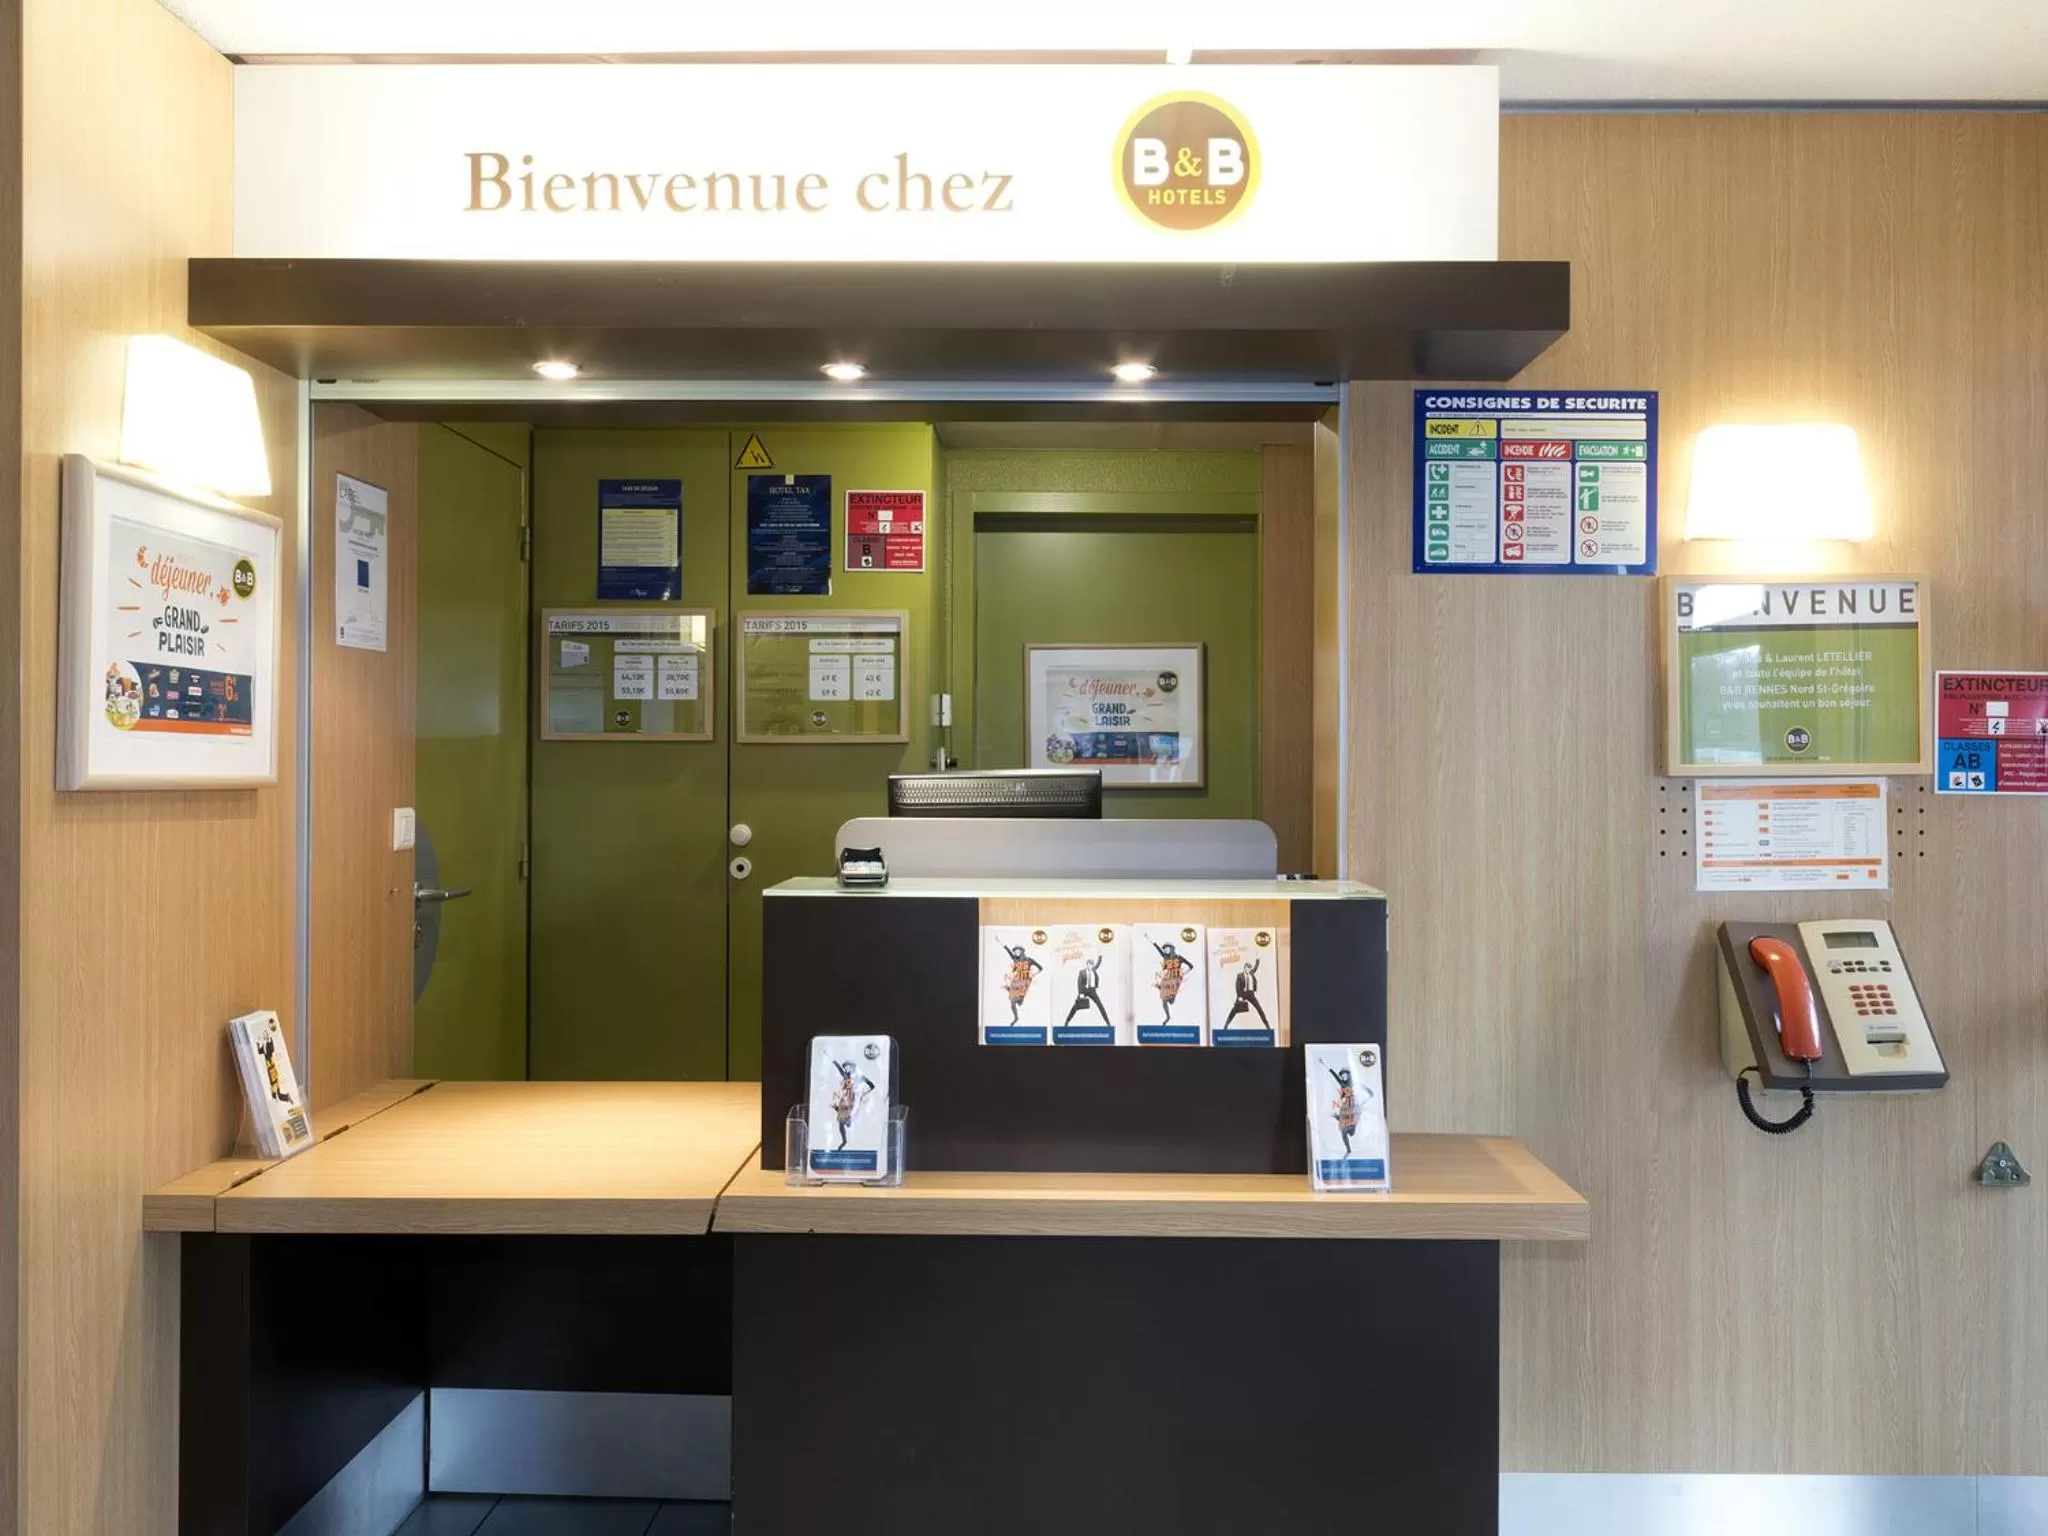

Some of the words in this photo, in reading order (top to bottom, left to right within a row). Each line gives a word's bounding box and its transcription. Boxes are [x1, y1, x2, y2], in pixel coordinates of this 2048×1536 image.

[1133, 137, 1245, 186] B&B
[462, 151, 829, 213] Bienvenue
[856, 151, 1014, 213] chez
[1148, 189, 1226, 205] HOTELS
[1425, 397, 1532, 409] CONSIGNES
[1536, 398, 1560, 409] DE
[1564, 398, 1647, 410] SECURITE
[1430, 424, 1459, 435] INCIDENT
[1429, 444, 1460, 455] ACCIDENT
[1504, 445, 1534, 456] INCENDIE
[850, 494, 922, 505] EXTINCTEUR
[164, 605, 201, 633] GRAND
[549, 621, 584, 630] TARIFS
[586, 621, 610, 630] 2015
[745, 621, 782, 630] TARIFS
[784, 621, 808, 630] 2015
[158, 631, 205, 657] PLAISIR
[1775, 653, 1814, 663] Laurent
[1816, 651, 1873, 662] LETELLIER
[1815, 667, 1828, 677] de
[1744, 684, 1788, 696] RENNES
[1789, 684, 1814, 694] Nord
[1092, 703, 1126, 714] GRAND
[1802, 700, 1816, 709] un
[1818, 699, 1838, 708] bon
[1095, 716, 1131, 726] LAISIR
[1943, 742, 1991, 751] CLASSES
[1953, 753, 1981, 769] AB
